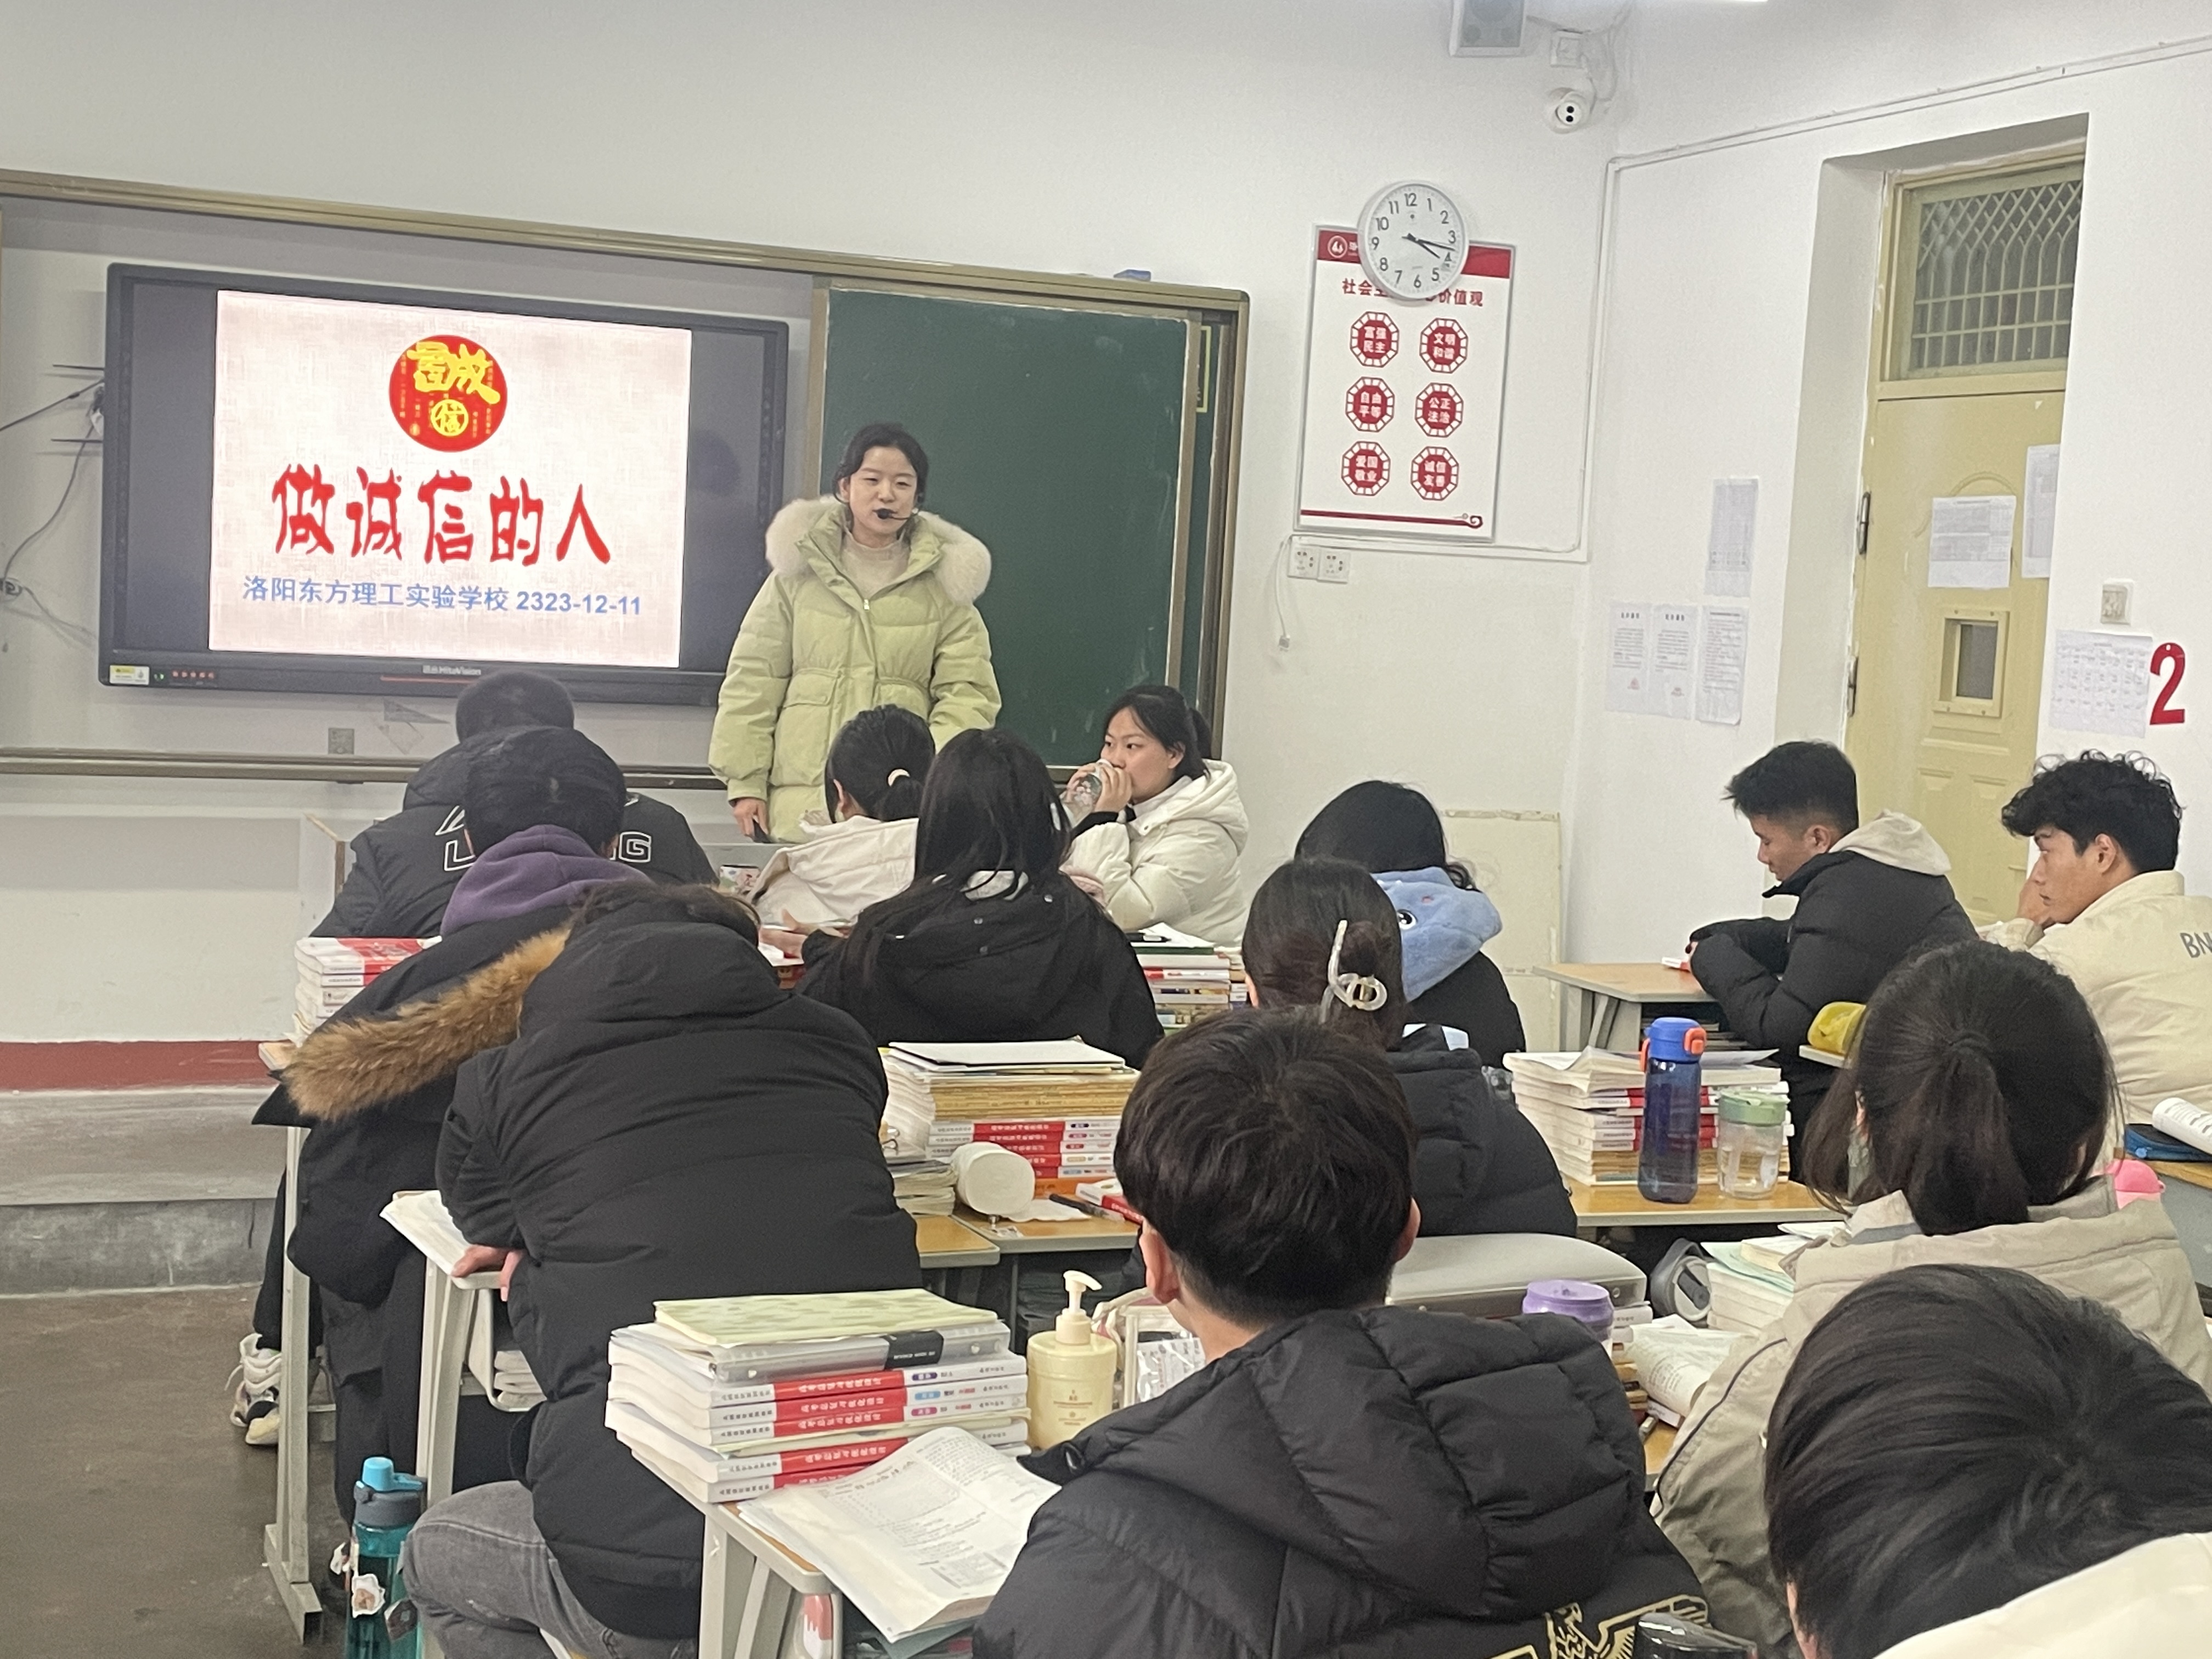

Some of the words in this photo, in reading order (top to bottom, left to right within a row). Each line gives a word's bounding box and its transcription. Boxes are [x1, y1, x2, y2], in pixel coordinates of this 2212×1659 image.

[1404, 193, 1418, 206] 12
[1427, 198, 1432, 211] 1
[1389, 200, 1400, 215] 11
[1375, 216, 1389, 231] 10
[1440, 210, 1449, 224] 2
[1372, 236, 1380, 250] 9
[1448, 230, 1456, 244] 3
[1380, 257, 1389, 271] 8
[1395, 269, 1403, 284] 7
[1413, 274, 1421, 288] 6
[1431, 267, 1440, 281] 5
[1363, 340, 1386, 353] 民主
[1428, 396, 1452, 410] 公正
[272, 463, 611, 567] 做诚信的人
[242, 575, 510, 612] 洛阳东方理工实验学校
[516, 591, 640, 615] 2323-12-11
[2149, 642, 2186, 725] 2
